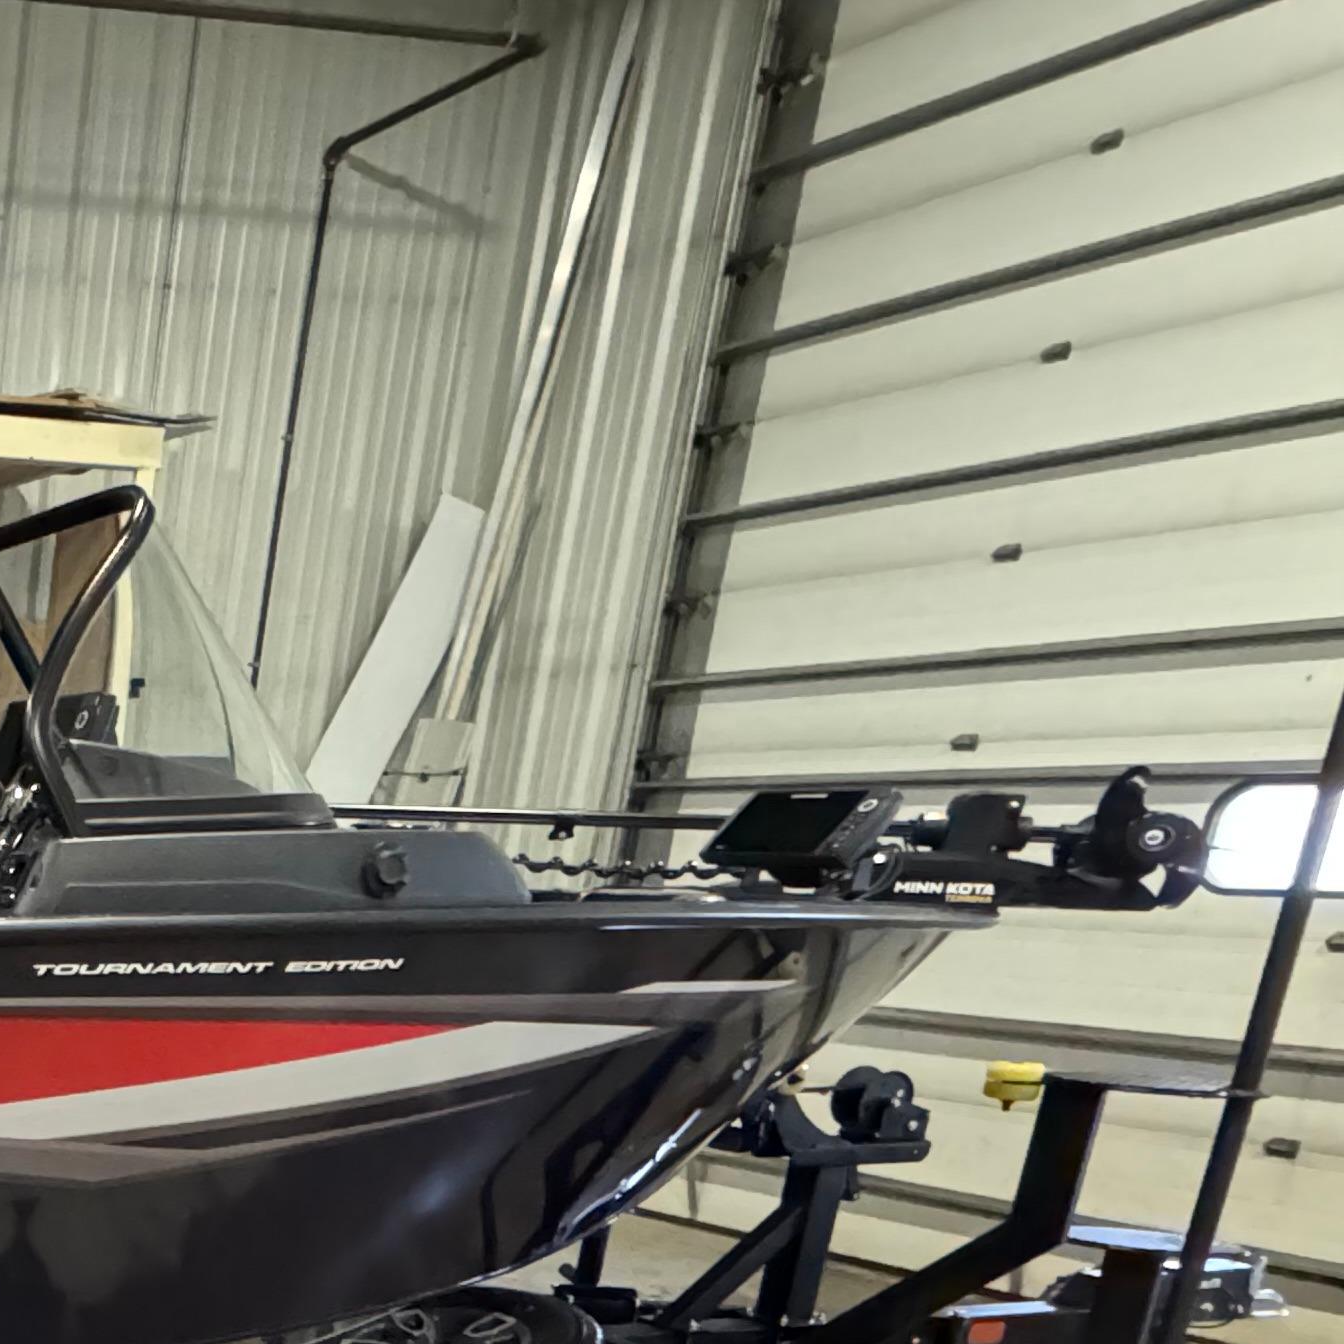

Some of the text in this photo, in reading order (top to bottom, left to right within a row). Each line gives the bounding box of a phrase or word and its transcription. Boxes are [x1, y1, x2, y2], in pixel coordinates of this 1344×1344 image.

[893, 880, 996, 896] MINN KOTA
[32, 957, 405, 977] TOURNAMENT EDITION
